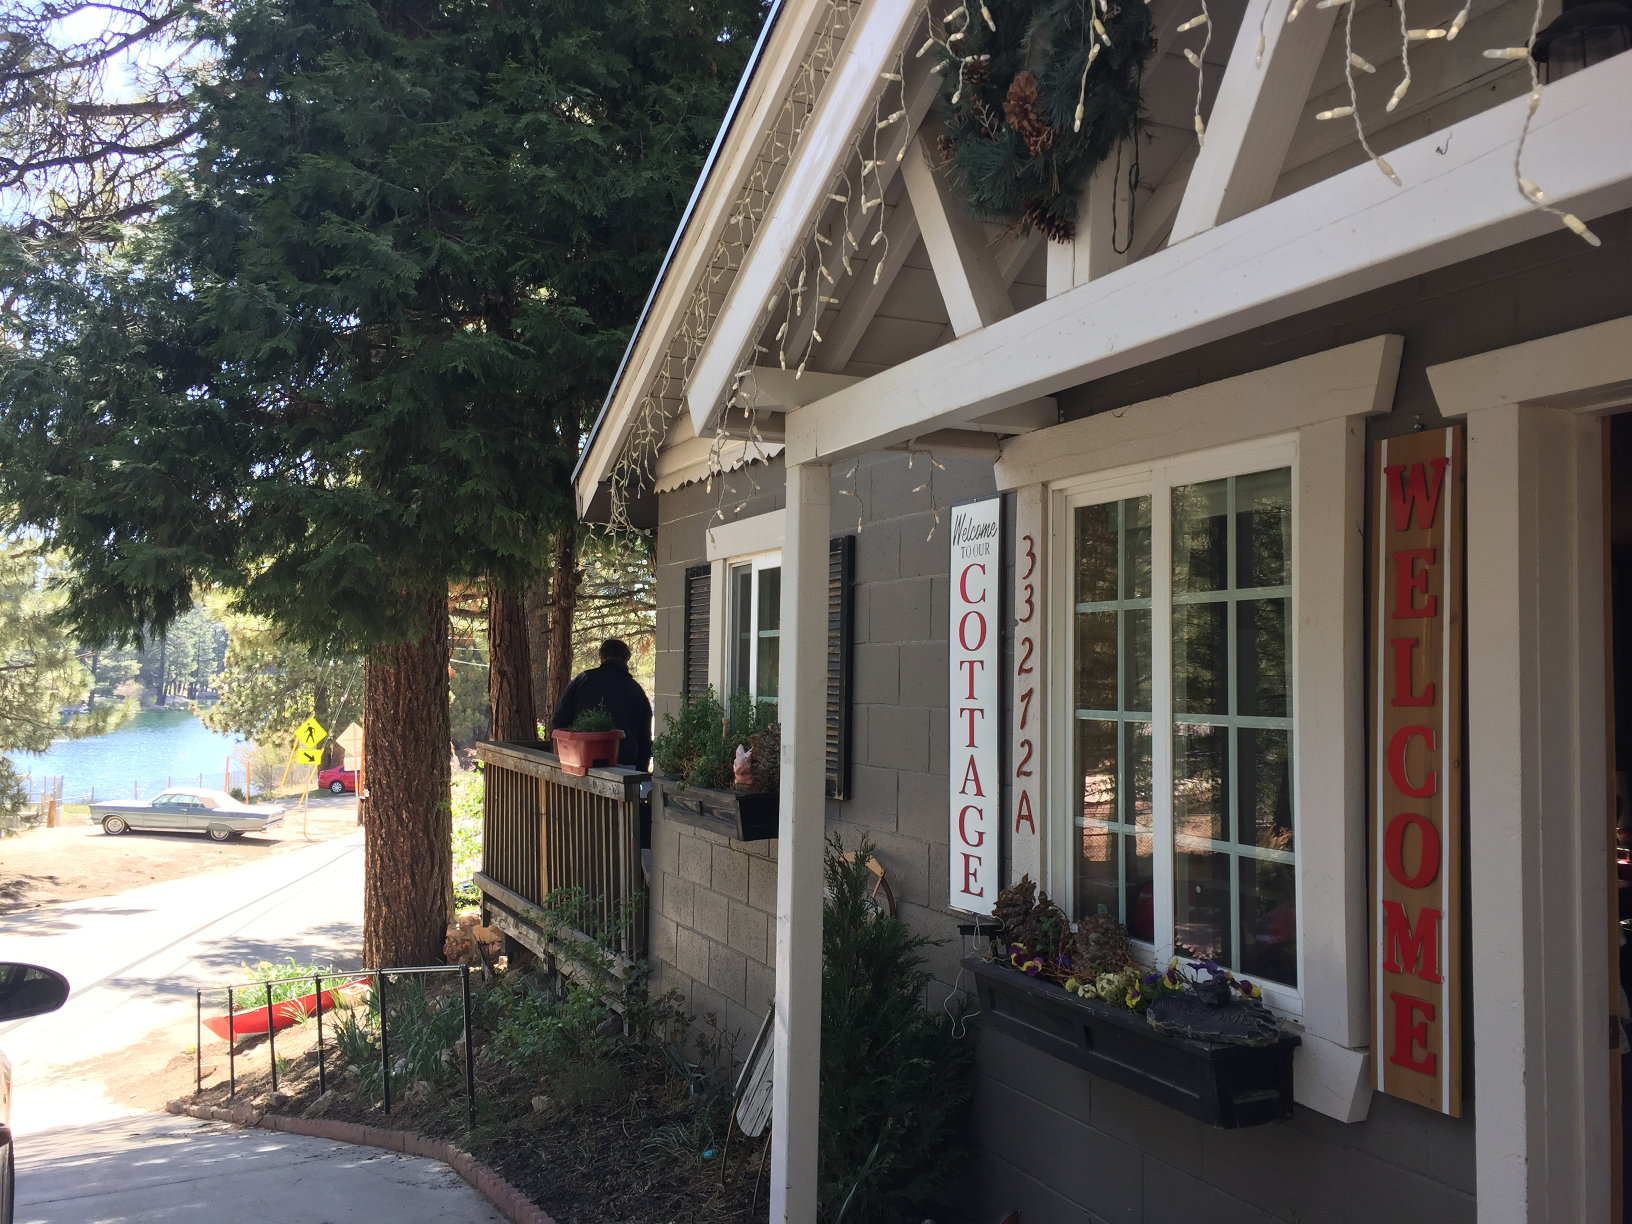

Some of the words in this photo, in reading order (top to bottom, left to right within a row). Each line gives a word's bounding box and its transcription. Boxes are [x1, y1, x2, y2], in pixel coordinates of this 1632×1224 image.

[952, 512, 998, 546] Welcome
[961, 545, 972, 559] TO
[972, 542, 991, 557] OUR
[958, 563, 986, 898] COTTAGE
[1383, 457, 1448, 1076] WELCOME
